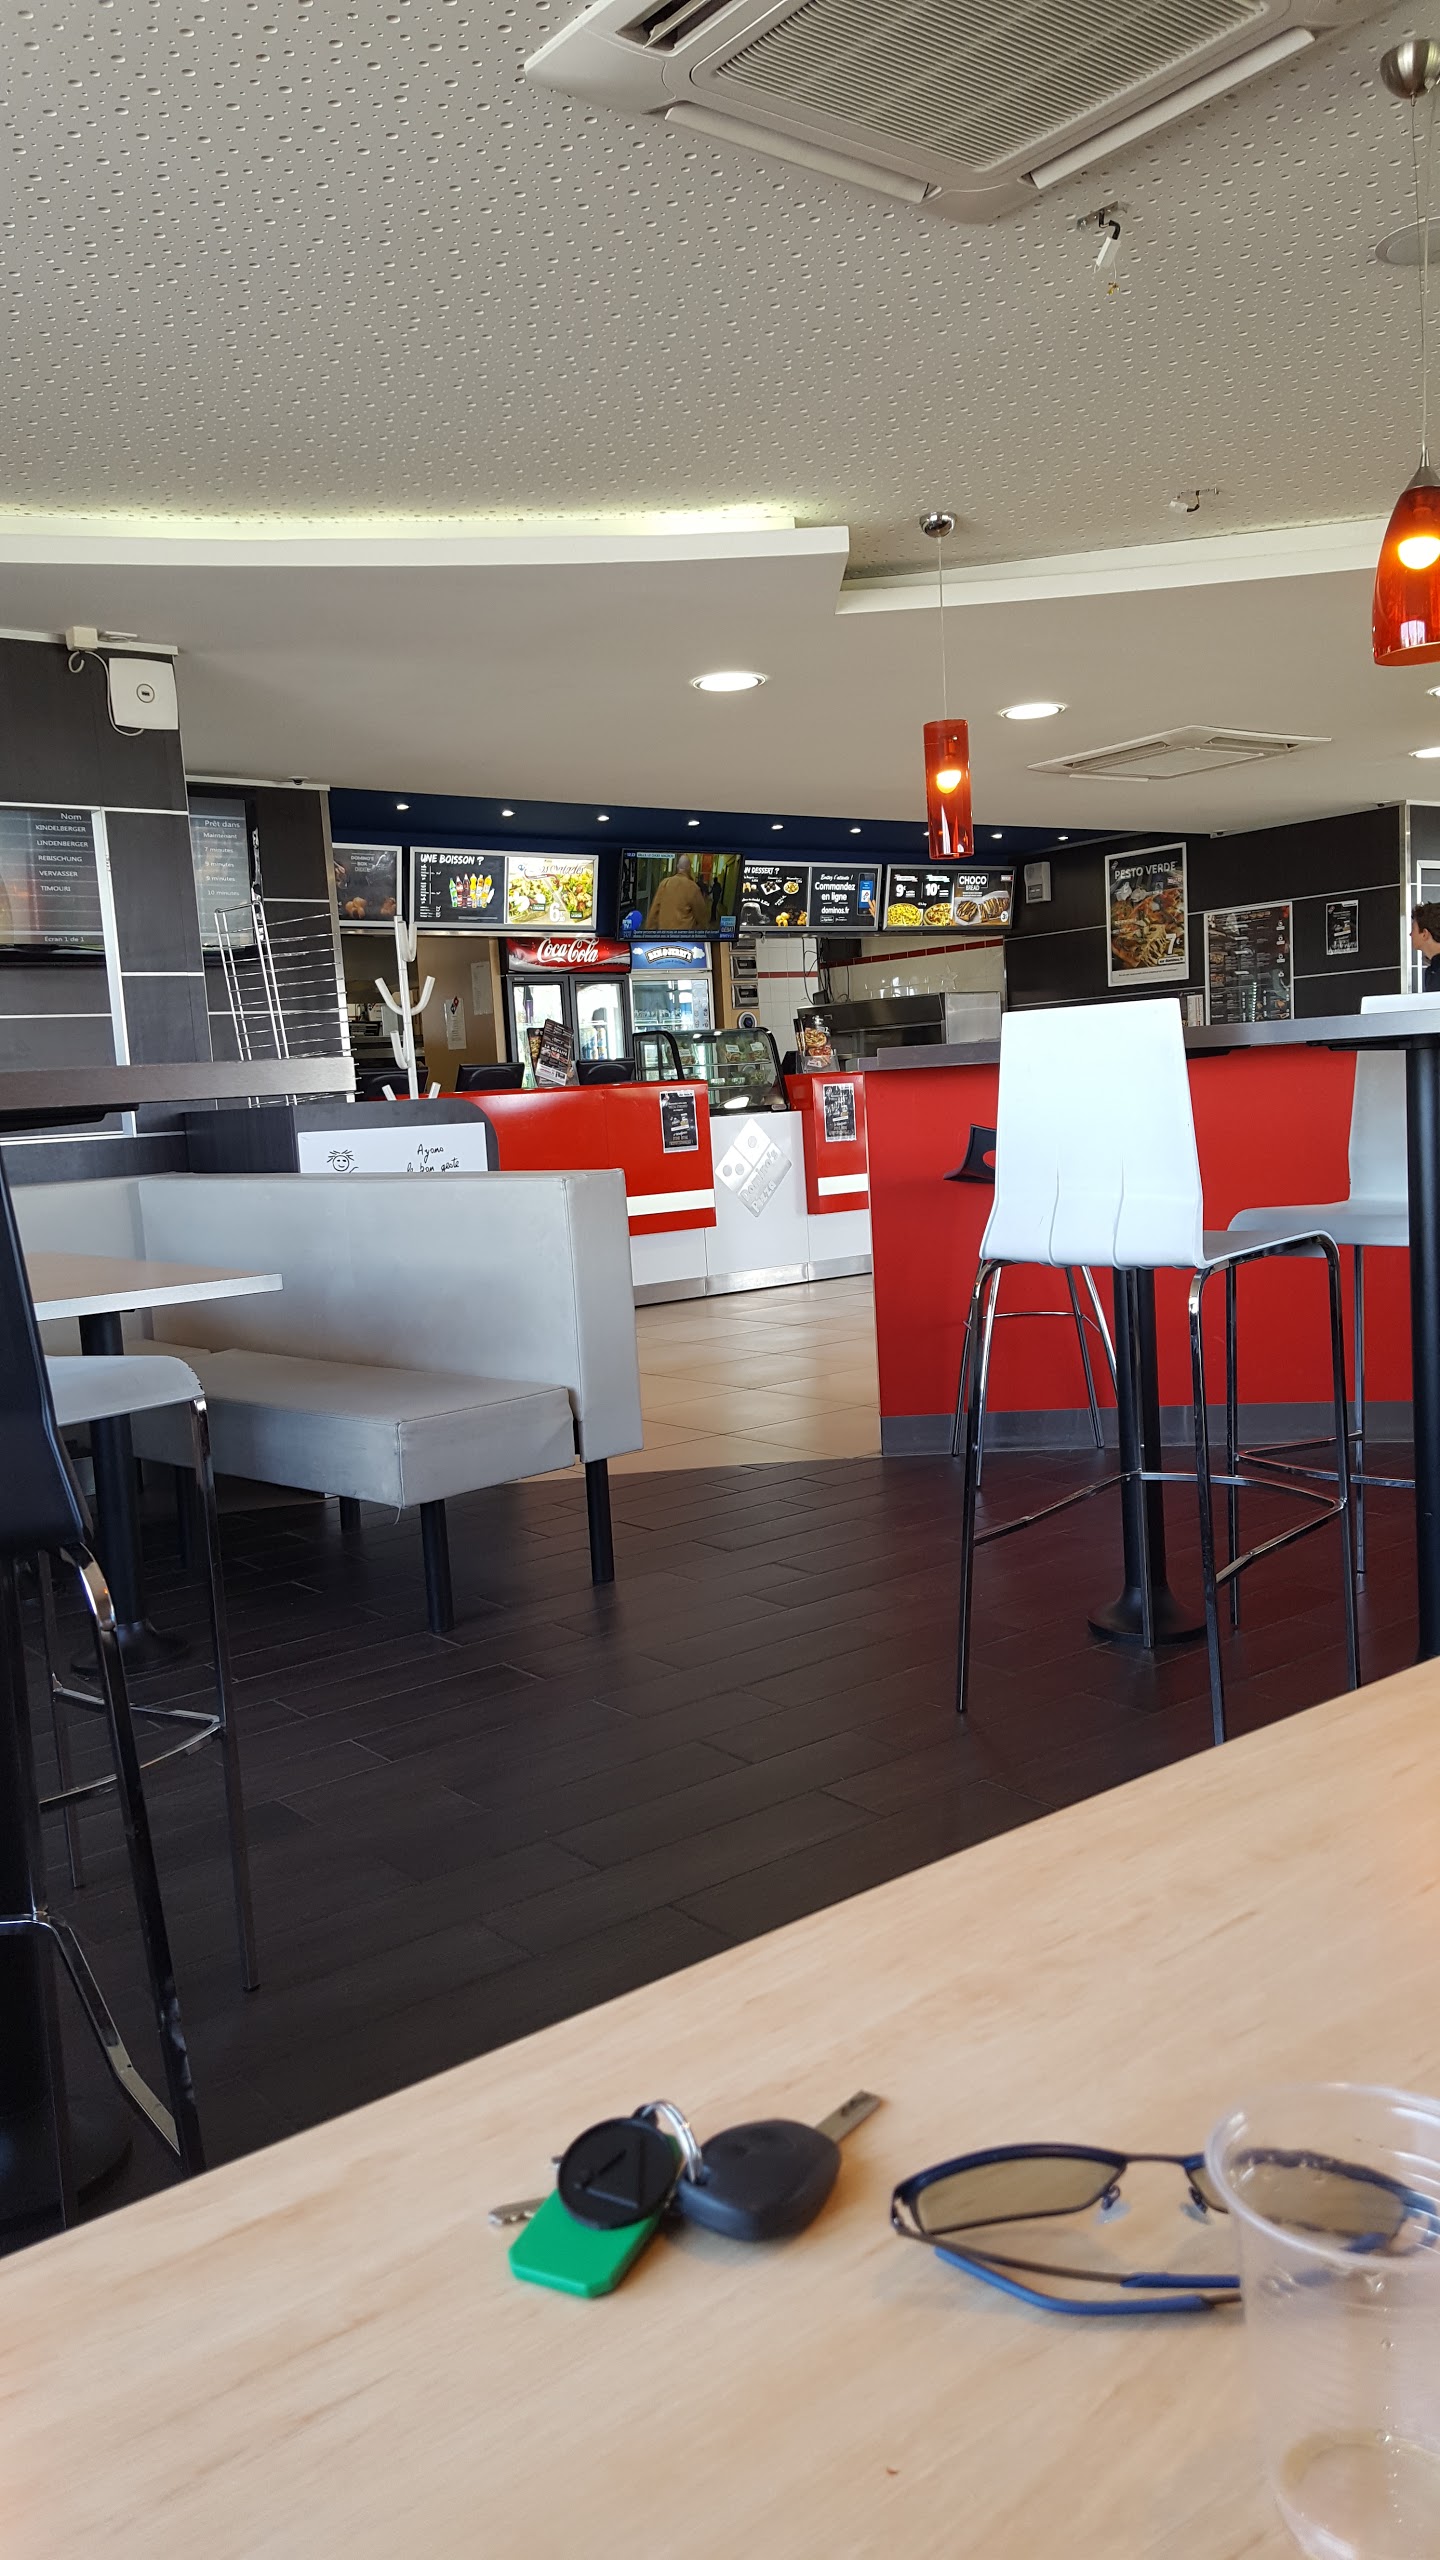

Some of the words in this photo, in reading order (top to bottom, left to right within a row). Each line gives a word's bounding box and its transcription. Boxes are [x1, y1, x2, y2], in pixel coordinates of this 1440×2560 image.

[60, 812, 82, 820] Nom
[35, 824, 87, 833] KINDELBERGER
[38, 855, 83, 863] REBISCHUNG
[420, 853, 438, 864] UNE
[439, 854, 476, 865] BOISSON
[476, 856, 485, 866] ?
[38, 870, 79, 878] VERVASSER
[751, 867, 775, 875] DESSERT
[774, 867, 780, 875] ?
[1114, 866, 1144, 880] PESTO
[1145, 860, 1176, 875] VERDE
[958, 875, 987, 885] CHOCO
[814, 881, 856, 891] Commandez
[821, 893, 830, 901] en
[831, 891, 848, 903] ligne
[821, 906, 850, 914] dominos.fr
[647, 949, 663, 961] BEN
[739, 1149, 778, 1202] Domino's
[750, 1179, 777, 1213] Pizza
